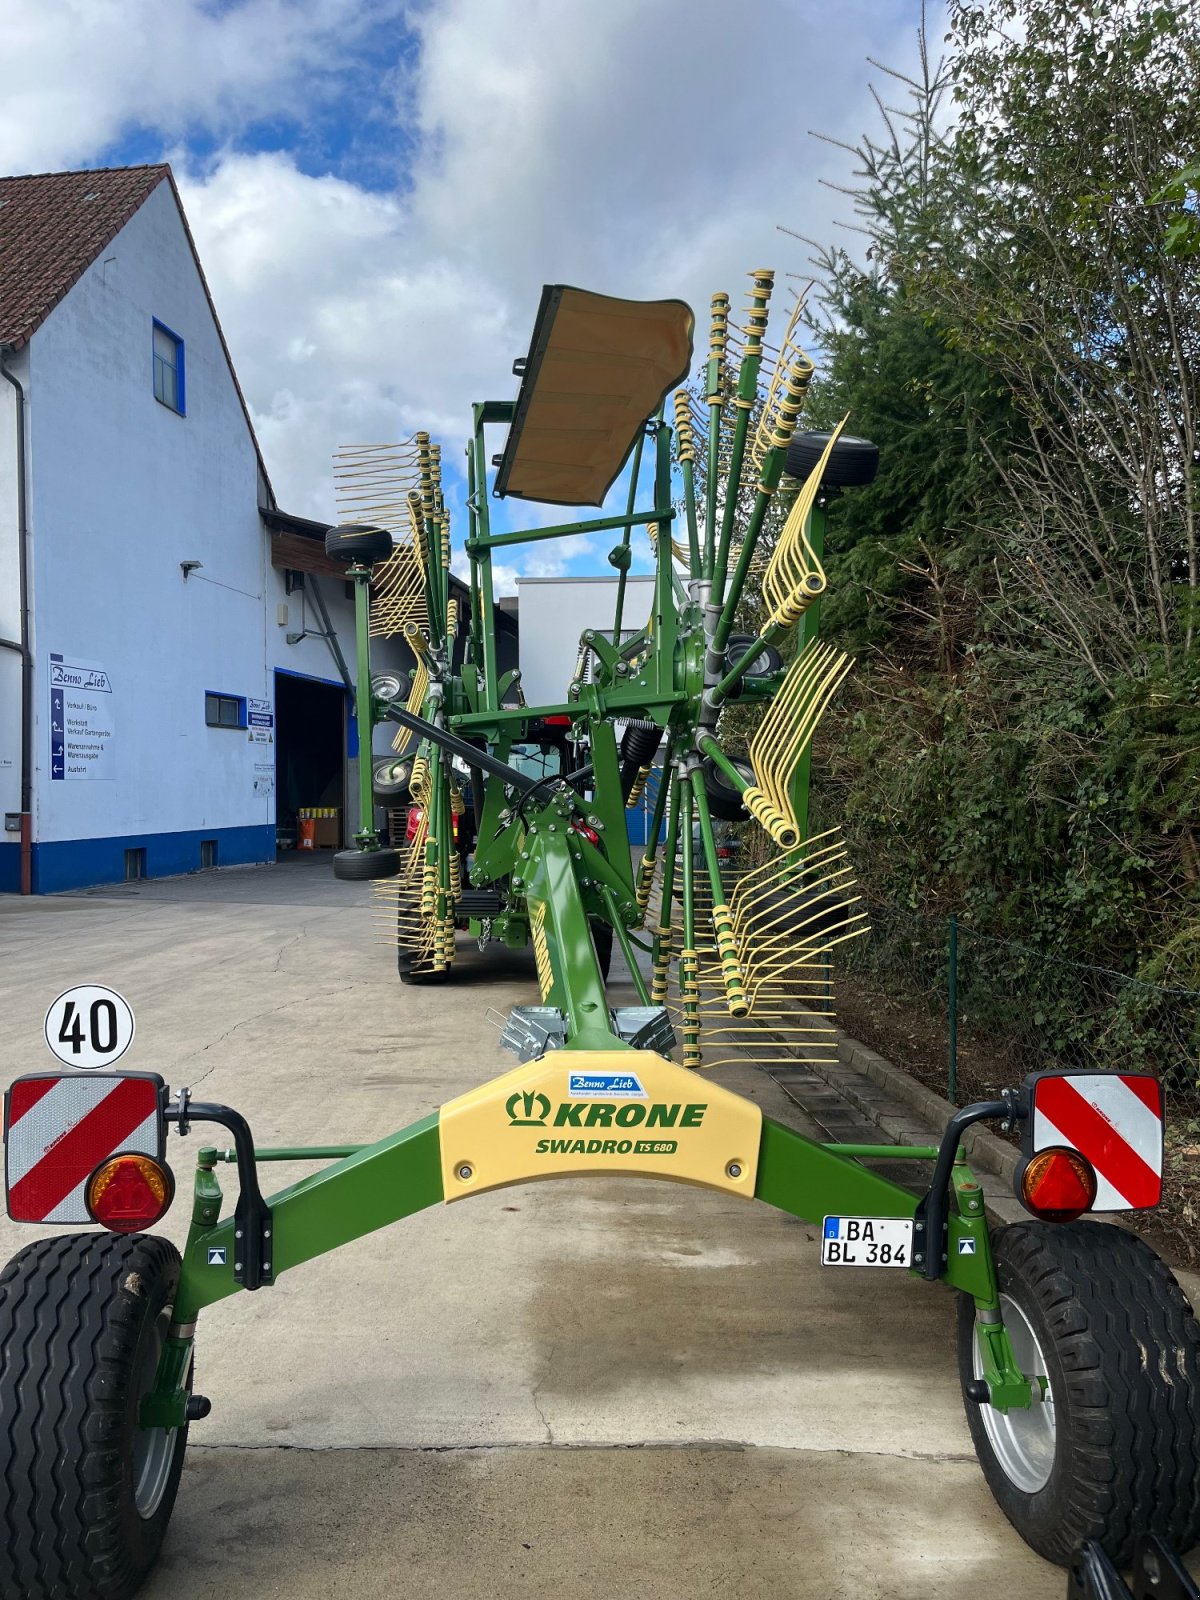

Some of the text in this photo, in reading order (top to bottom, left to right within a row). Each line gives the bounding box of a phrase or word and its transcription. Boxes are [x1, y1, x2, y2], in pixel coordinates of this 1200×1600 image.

[53, 666, 106, 688] Benno Lieb
[67, 701, 84, 710] Verkauf
[67, 719, 88, 727] Werkstatt
[67, 728, 84, 736] Verkauf
[58, 999, 118, 1054] 40
[572, 1076, 633, 1090] Benno Lieb
[552, 1103, 709, 1128] KRONE
[535, 1139, 673, 1154] SWADRO TS 680
[829, 1230, 835, 1238] D
[847, 1221, 875, 1241] BA
[828, 1242, 905, 1264] BL 384
